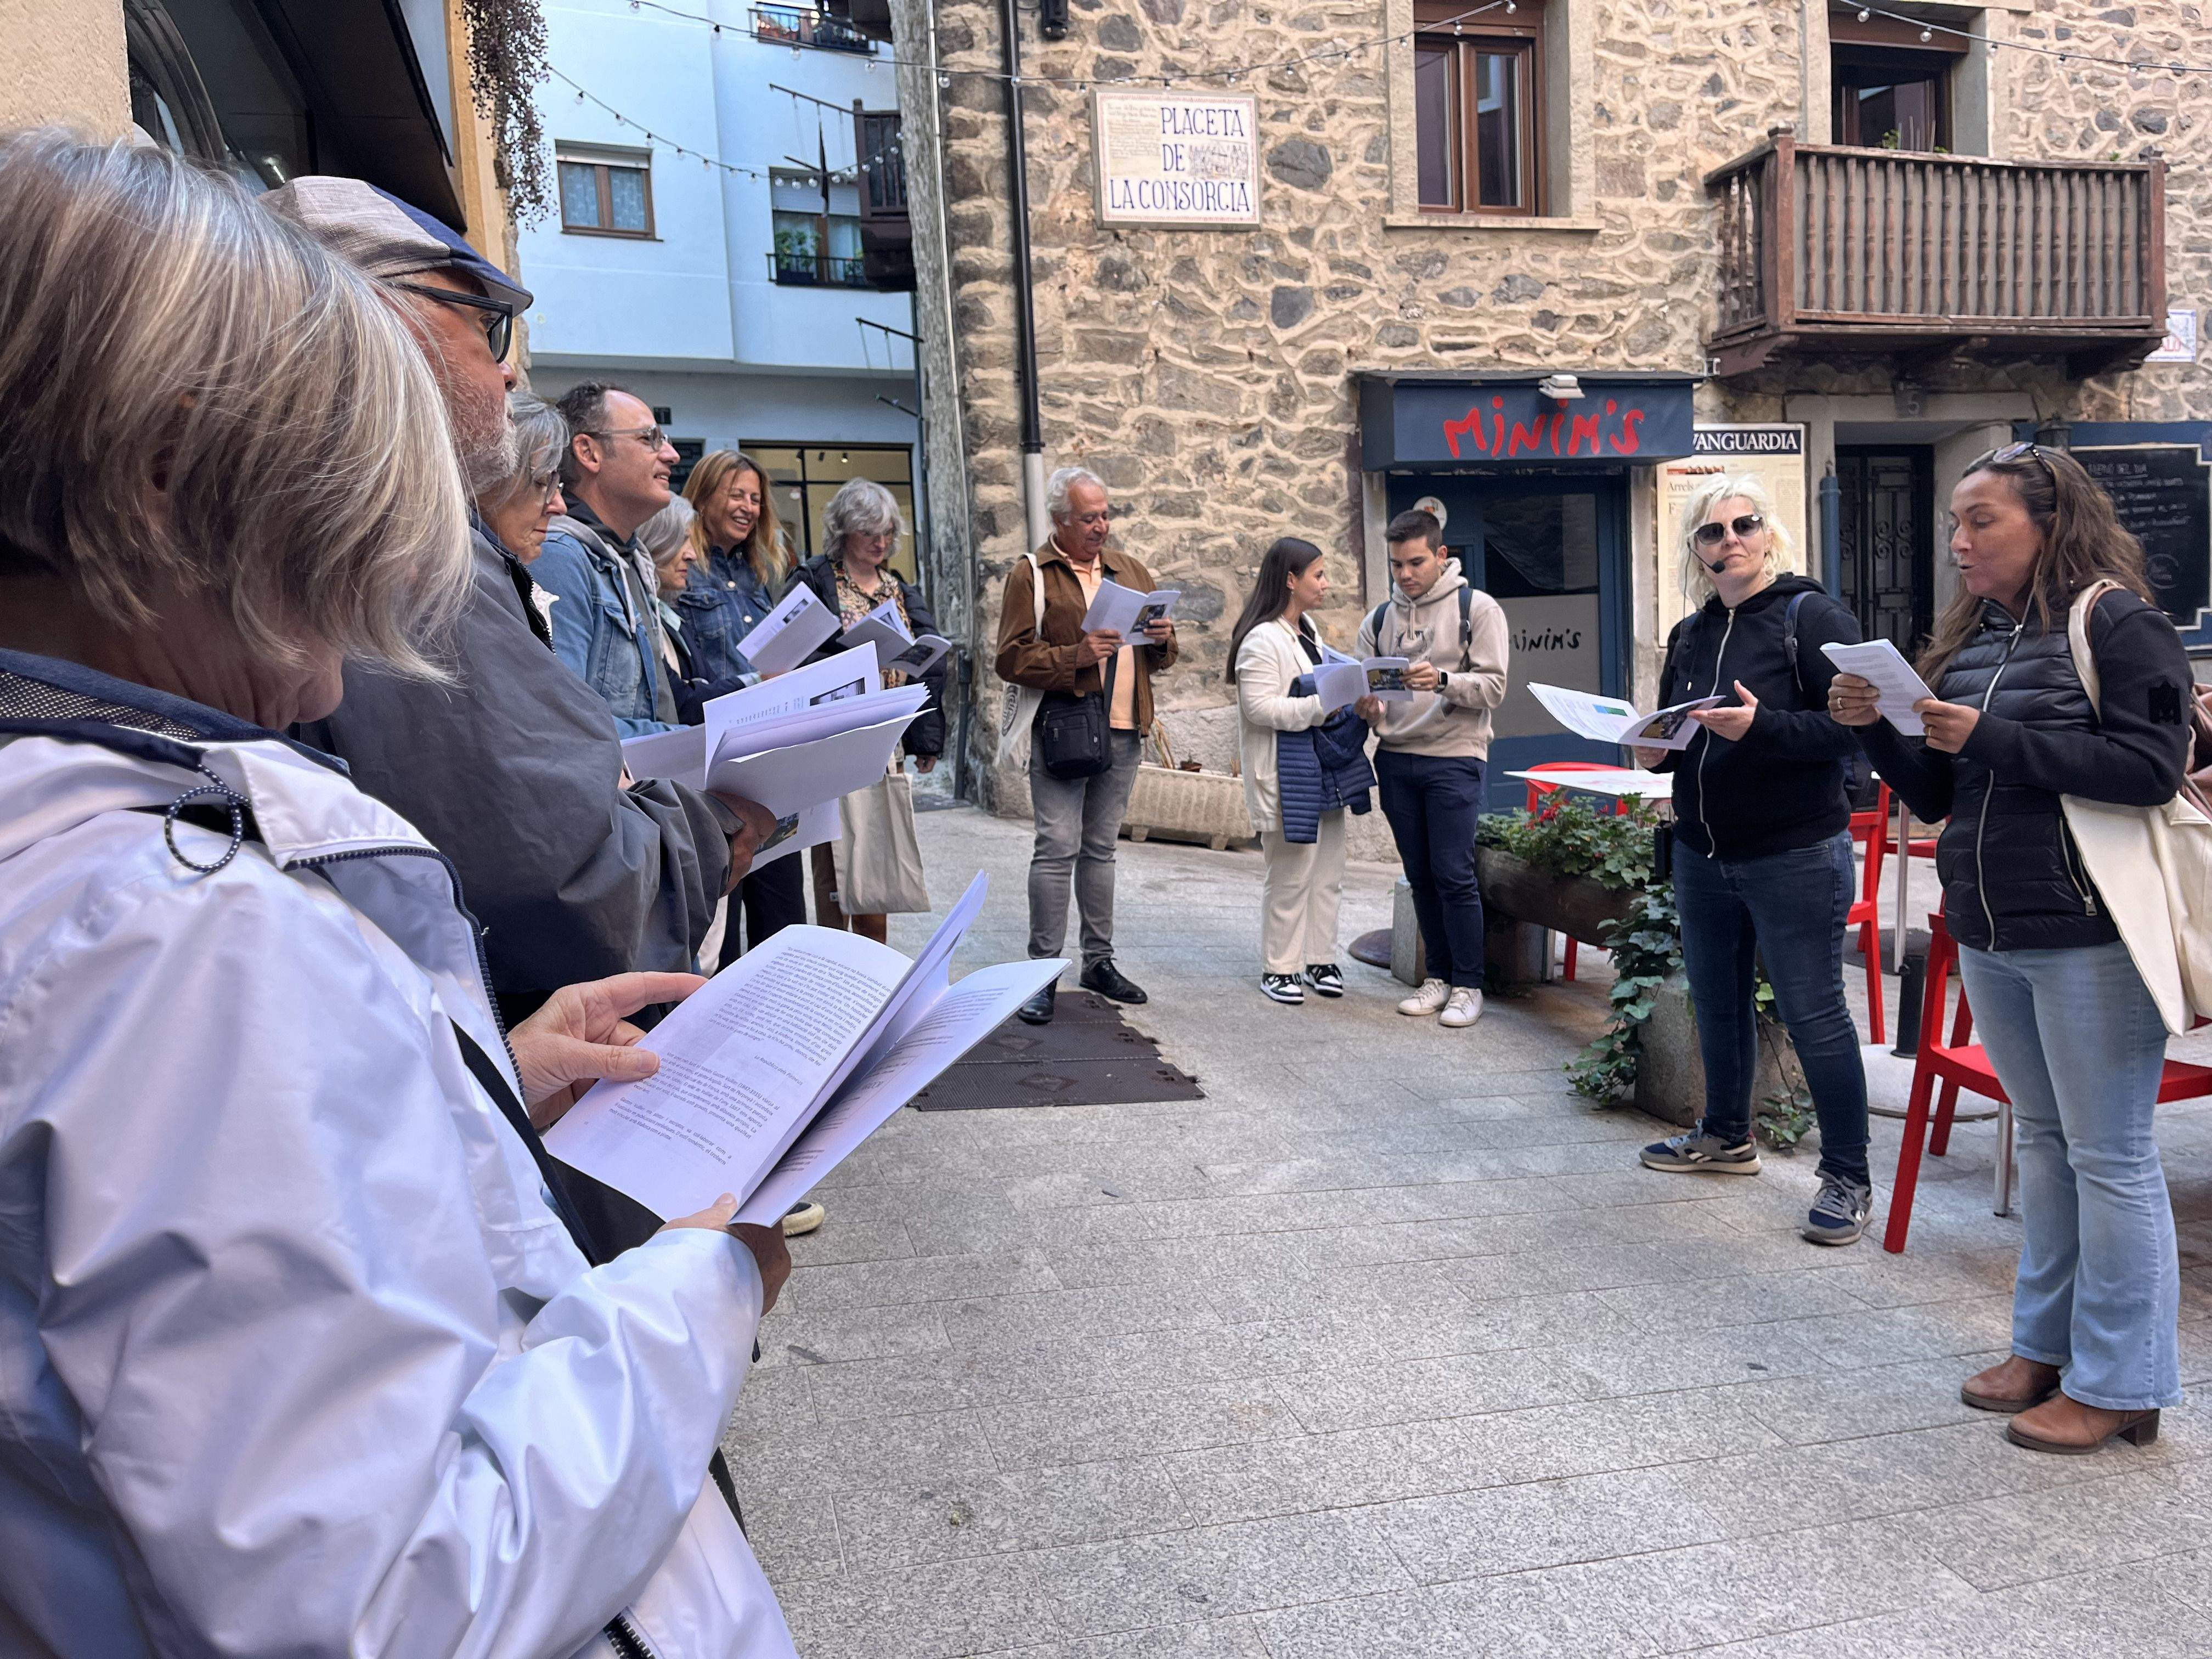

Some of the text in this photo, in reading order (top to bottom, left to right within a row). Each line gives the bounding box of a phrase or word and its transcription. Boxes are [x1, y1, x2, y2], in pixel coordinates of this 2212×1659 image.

[1161, 108, 1244, 137] PLACETA
[1163, 144, 1184, 171] DE
[1110, 179, 1250, 212] LA CONSORCIA
